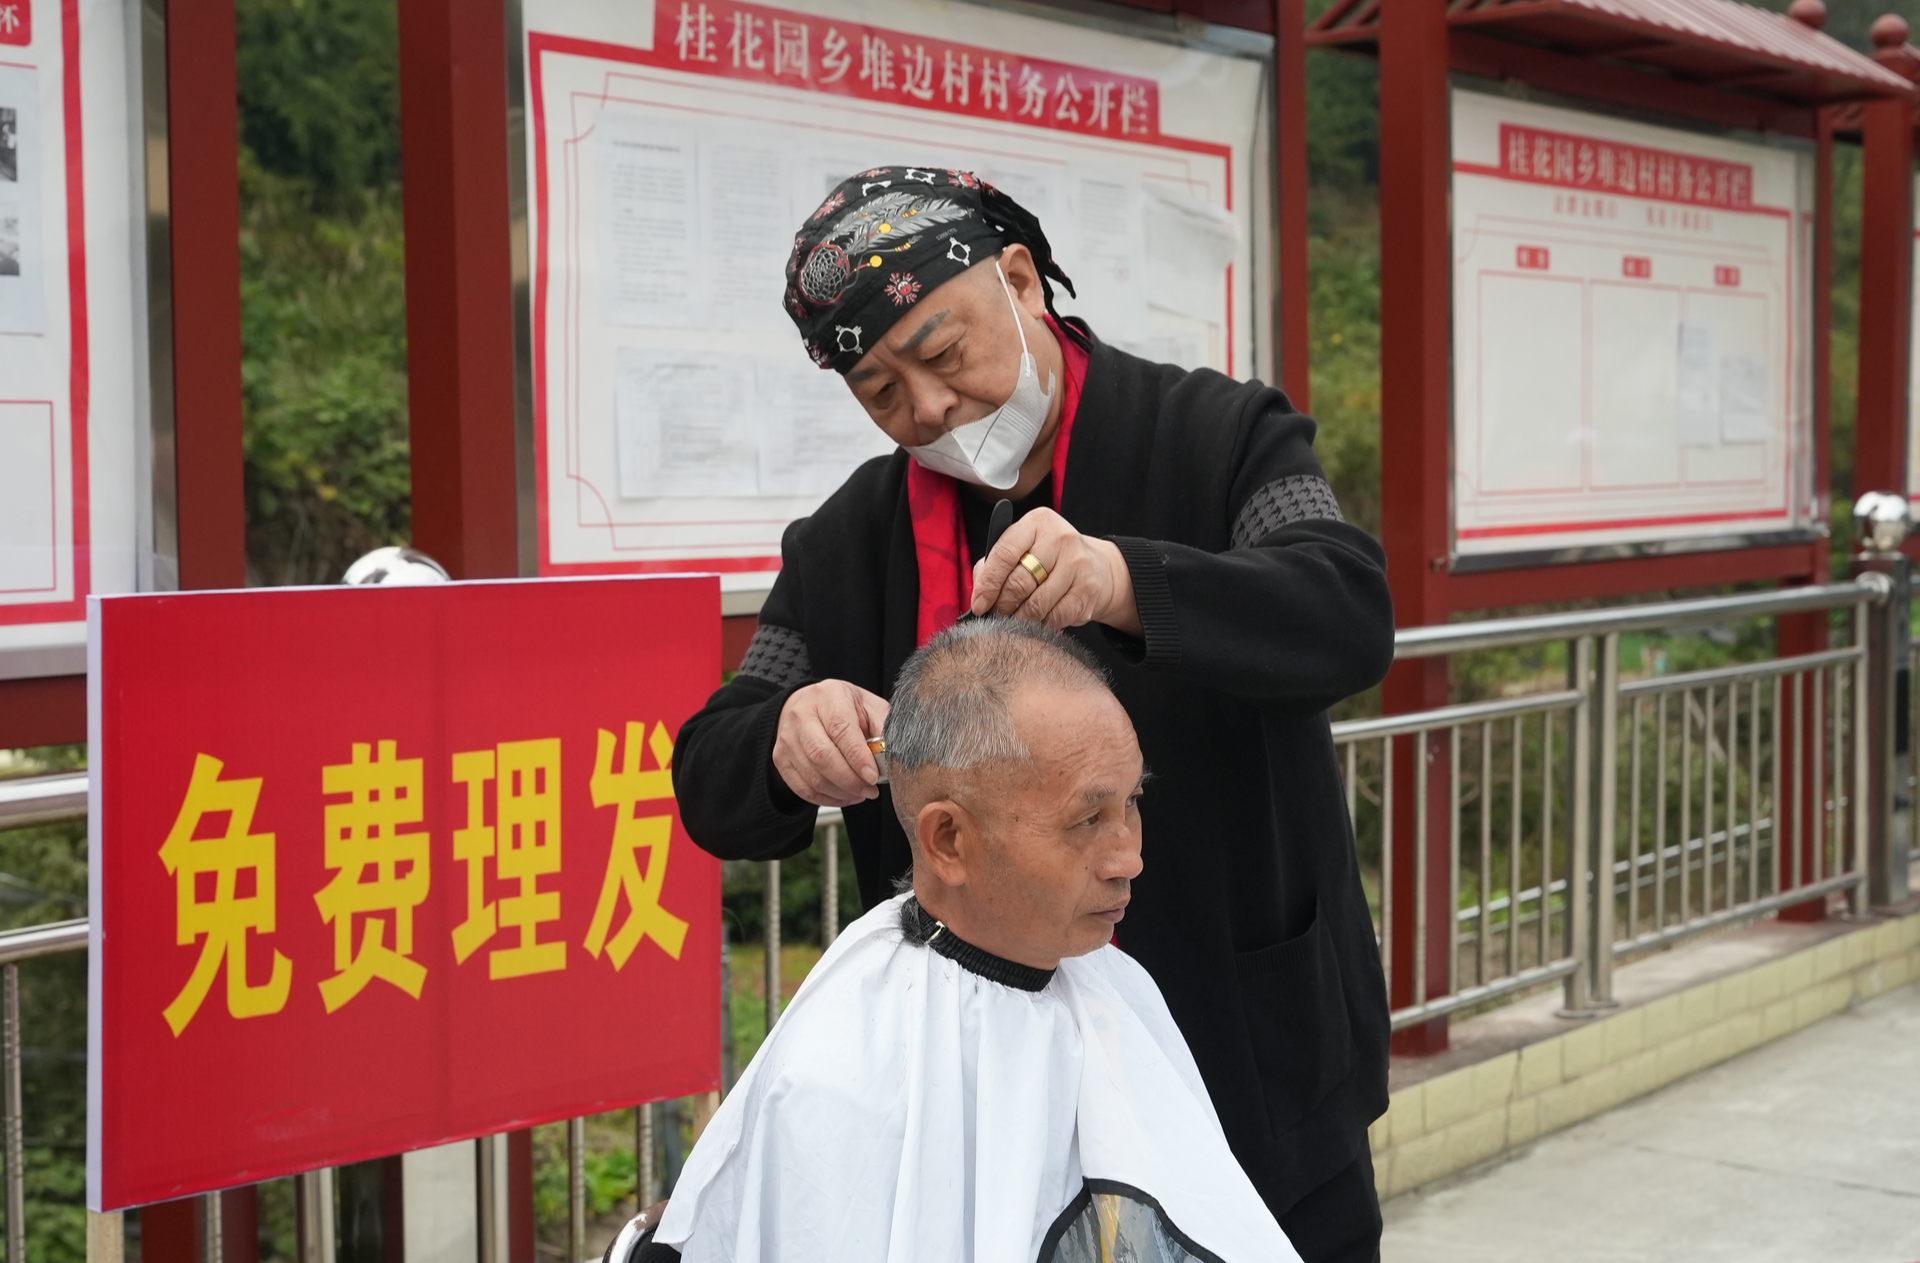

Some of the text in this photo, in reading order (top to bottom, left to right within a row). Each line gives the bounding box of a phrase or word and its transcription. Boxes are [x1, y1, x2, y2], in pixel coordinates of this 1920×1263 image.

[674, 1, 1149, 136] 桂花园乡堆边村村务公开栏
[158, 720, 690, 1039] 免费理发
